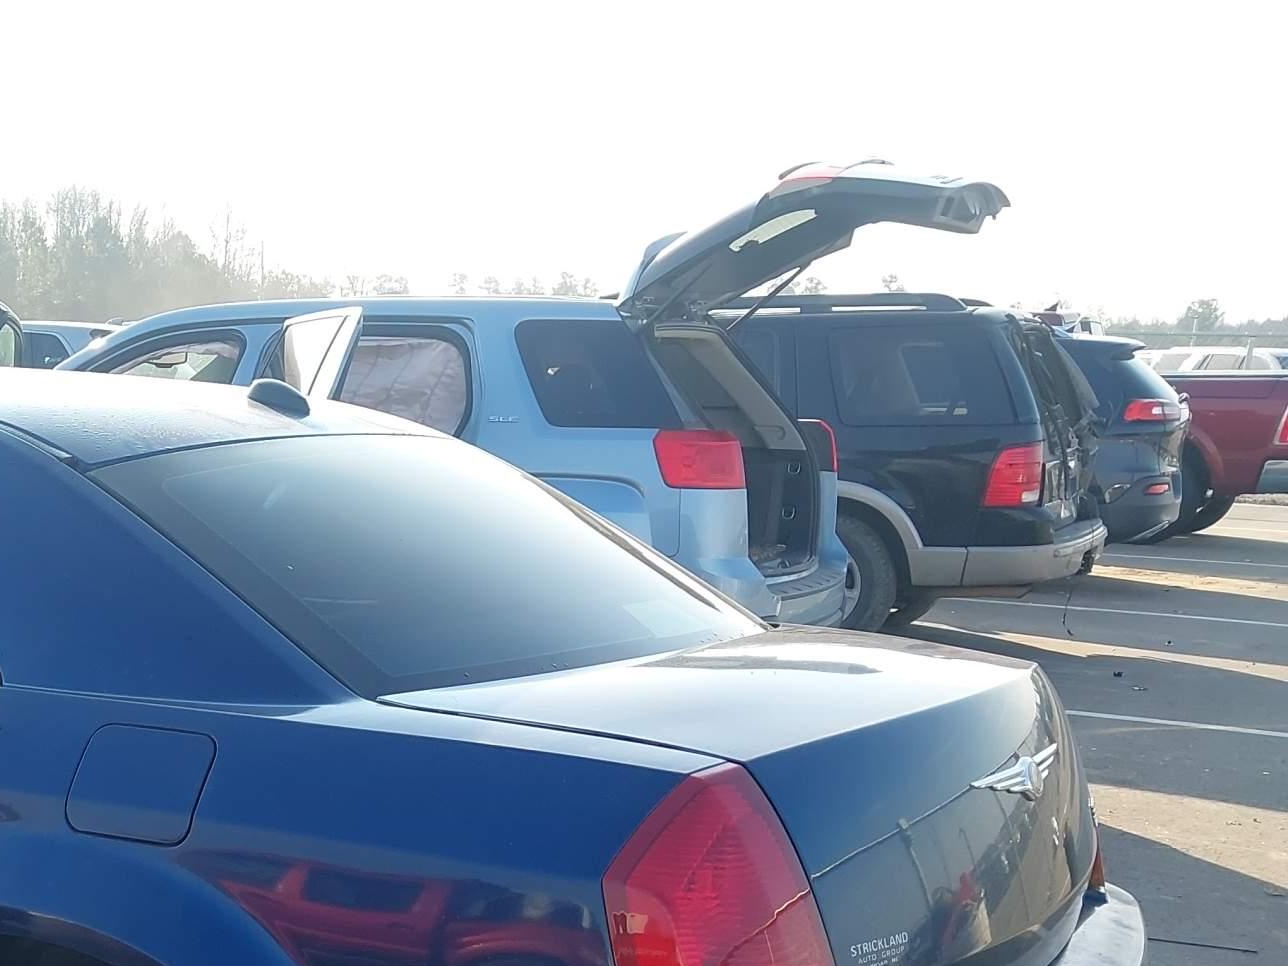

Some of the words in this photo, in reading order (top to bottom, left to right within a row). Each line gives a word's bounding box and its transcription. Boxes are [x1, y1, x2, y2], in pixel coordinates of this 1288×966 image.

[850, 931, 909, 957] STRICKLAND
[858, 953, 877, 965] AUTO
[881, 945, 905, 958] GROUP
